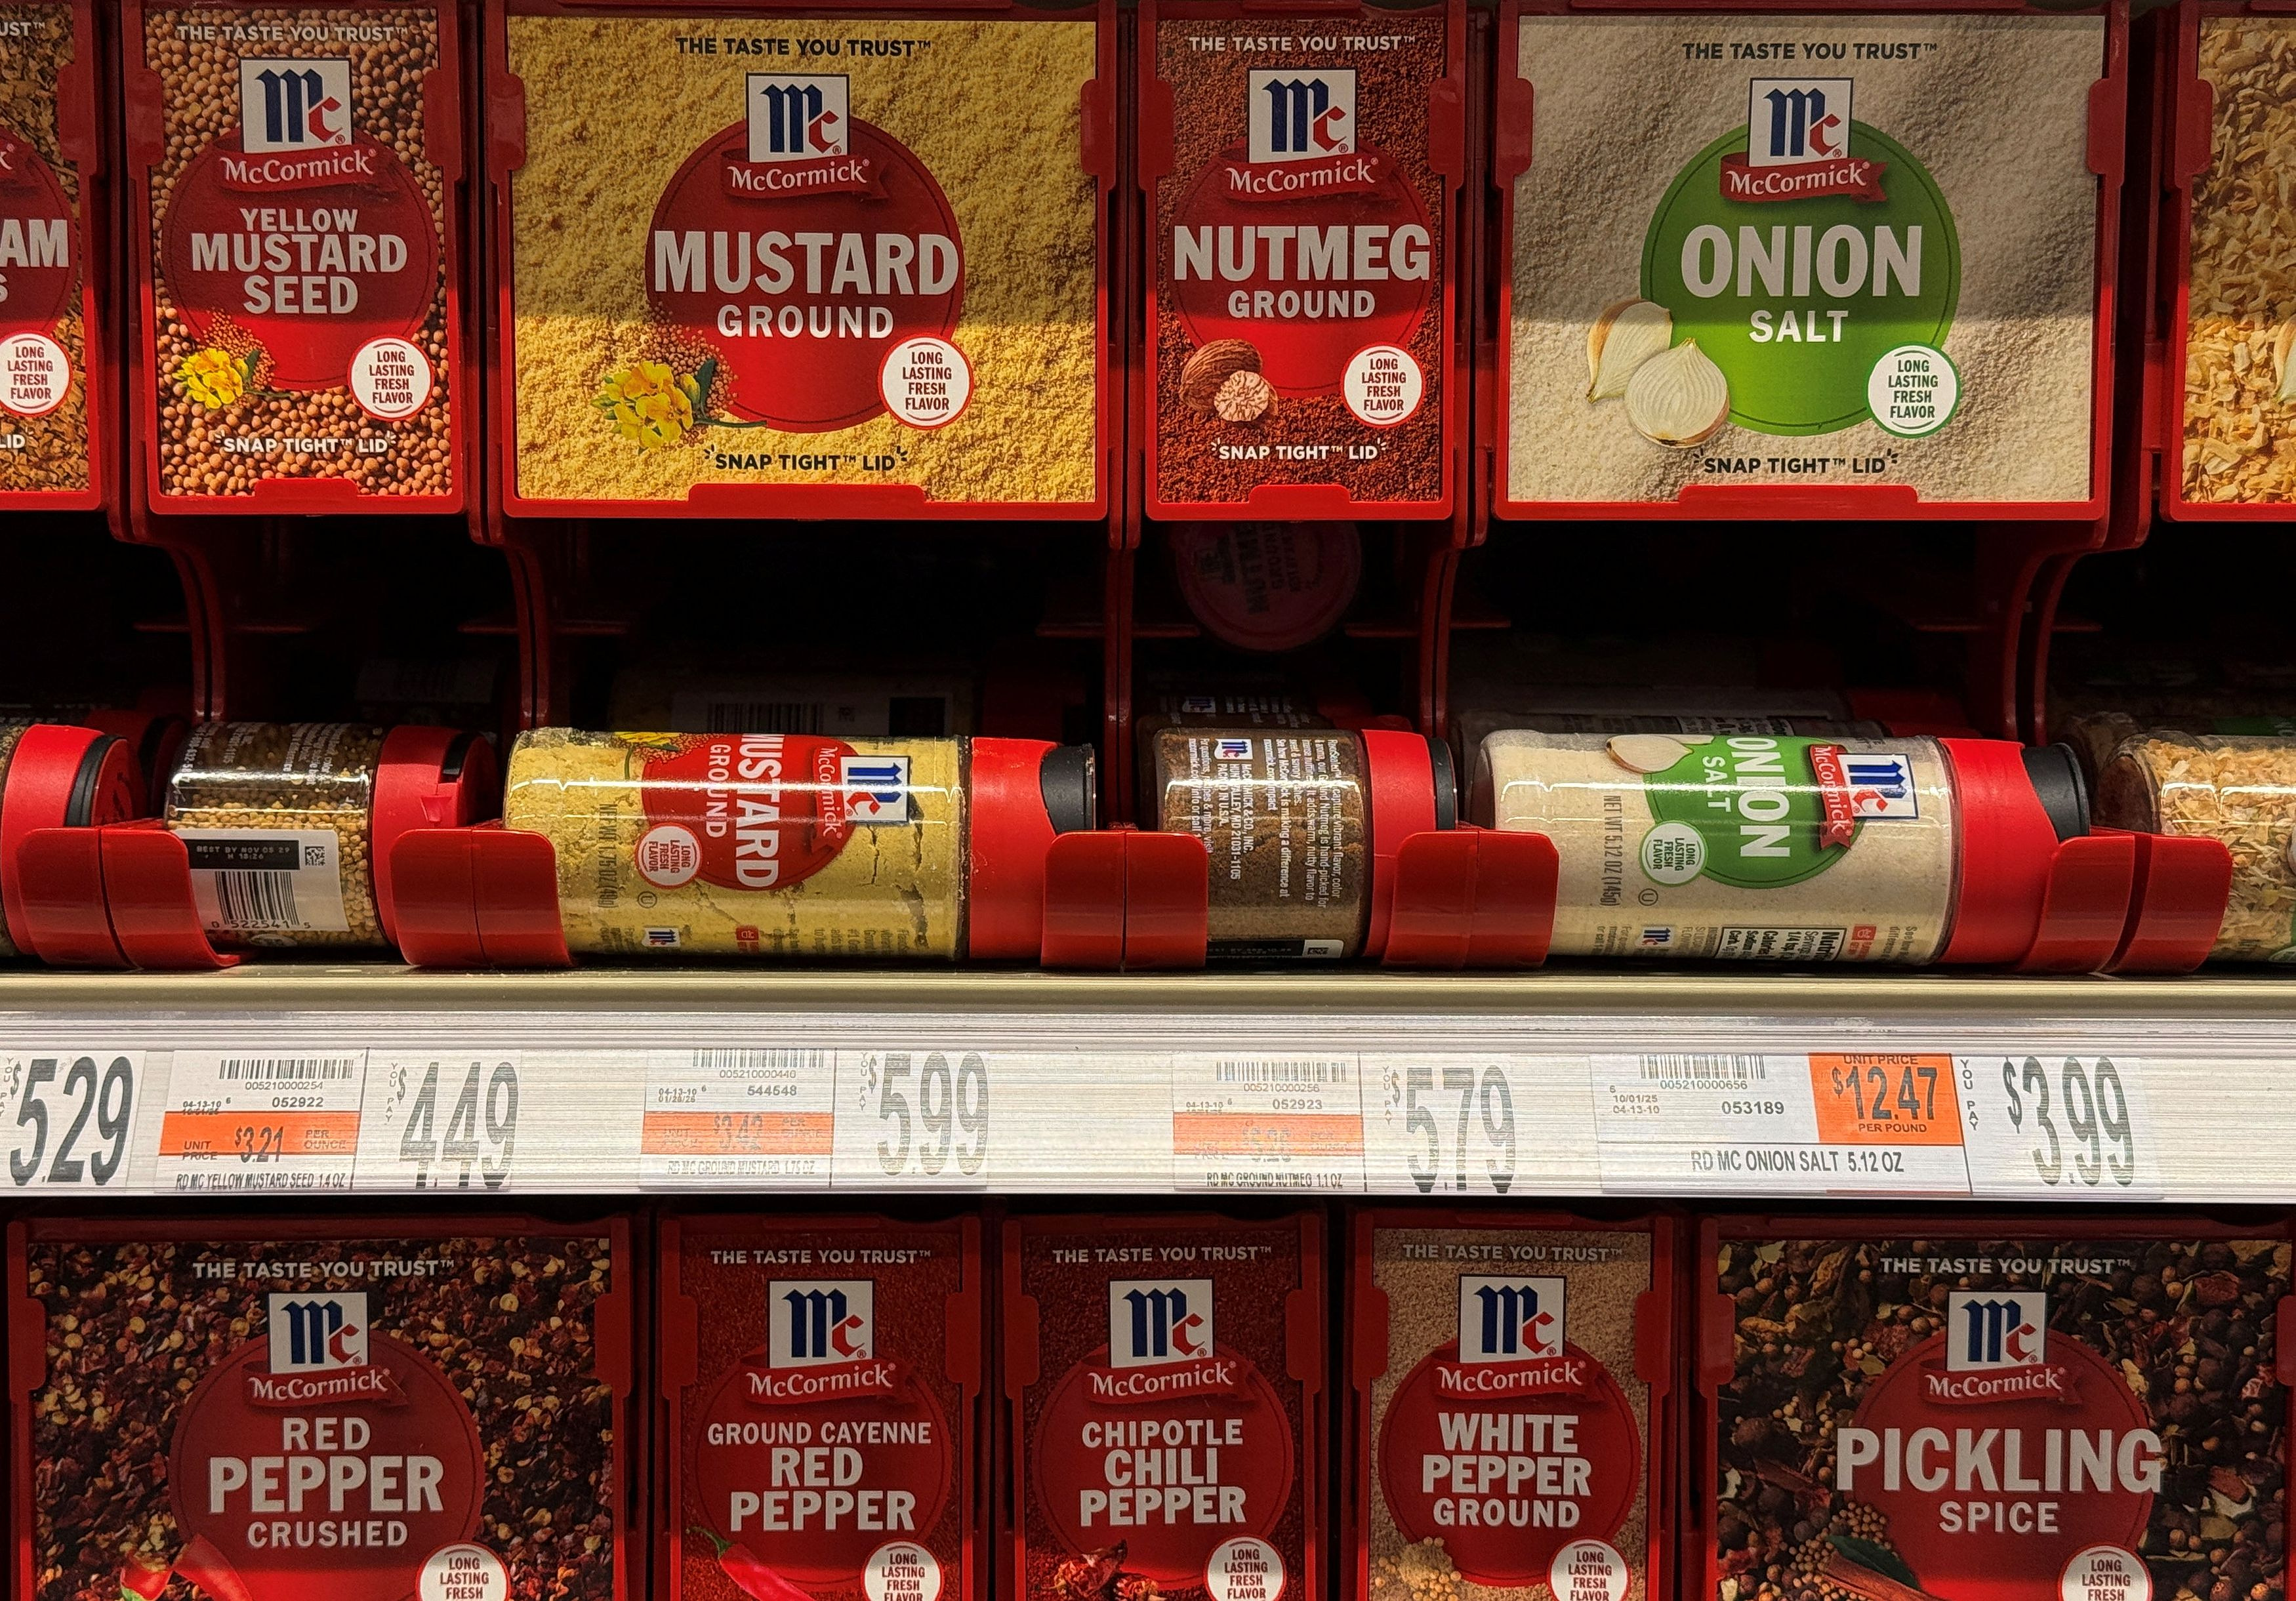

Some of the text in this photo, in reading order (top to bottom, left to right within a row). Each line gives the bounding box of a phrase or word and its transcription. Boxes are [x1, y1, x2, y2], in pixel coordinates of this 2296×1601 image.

[178, 26, 215, 40] THE
[222, 27, 283, 41] TASTE
[290, 28, 329, 41] YOU
[676, 37, 717, 54] THE
[724, 38, 789, 55] TASTE
[797, 39, 840, 56] YOU
[1189, 36, 1226, 51] THE
[1233, 36, 1292, 52] TASTE
[1300, 36, 1338, 52] YOU
[240, 208, 358, 233] YELLOW
[191, 233, 408, 272] MUSTARD
[655, 231, 958, 296] MUSTARD
[1174, 224, 1431, 281] NUTMEG
[1681, 224, 1923, 298] ONION
[243, 275, 358, 314] SEED
[1228, 290, 1376, 318] GROUND
[717, 305, 893, 339] GROUND
[1749, 310, 1849, 343] SALT
[16, 347, 44, 358] LONG
[377, 351, 405, 363] LONG
[8, 361, 53, 372] LASTING
[13, 374, 48, 385] FRESH
[369, 364, 415, 377] LASTING
[10, 388, 51, 399] FLAVOR
[375, 377, 410, 390] FRESH
[372, 392, 413, 405] FLAVOR
[223, 438, 276, 453] SNAP
[358, 438, 388, 453] LID
[1705, 457, 1761, 474] SNAP
[1853, 458, 1887, 474] LID
[706, 744, 731, 838] GROUND
[1727, 738, 1790, 857] ONION
[736, 734, 785, 887] MUSTARD
[1604, 796, 1622, 813] NET
[1332, 821, 1343, 850] vibrant
[1605, 816, 1622, 833] WT
[649, 841, 658, 872] FLAVOR
[660, 843, 669, 870] FRESH
[670, 840, 680, 873] LASTING
[682, 845, 691, 868] LONG
[1230, 830, 1241, 880] 21031-1105
[1279, 808, 1291, 887] making difference
[1605, 836, 1622, 856] 5.12
[1653, 840, 1662, 870] FLAVOR
[1664, 841, 1673, 867] FRESH
[1675, 838, 1684, 871] LASTING
[1686, 843, 1695, 865] LONG
[1318, 846, 1330, 895] hand-picked
[1605, 861, 1622, 874] OZ
[1331, 878, 1342, 898] color
[1599, 876, 1622, 906] (145g)
[1843, 1055, 1919, 1065] UNIT PRICE
[245, 1082, 323, 1090] 005210000254
[1660, 1080, 1748, 1090] 005210000656
[1832, 1065, 1937, 1120] $12.47
[272, 1097, 324, 1108] 052922
[1273, 1099, 1323, 1110] 052923
[1612, 1095, 1658, 1103] 10/01/25
[1721, 1101, 1785, 1115] 053189
[10, 1056, 134, 1186] $5.29
[397, 1062, 518, 1189] $4.49
[869, 1052, 989, 1175] $5.99
[2003, 1055, 2134, 1186] $3.99
[1858, 1124, 1927, 1133] PER POUND
[182, 1152, 218, 1160] PRICE
[184, 1141, 212, 1150] UNIT
[235, 1125, 284, 1163] $3.21
[1691, 1150, 1904, 1173] RD MC ONION SALT 5.12 OZ
[207, 1173, 244, 1188] YELLOW
[245, 1173, 289, 1188] MUSTARD
[290, 1173, 314, 1188] SEED
[1236, 1173, 1273, 1188] GROUND
[1275, 1173, 1312, 1188] NUTMEG
[1403, 1244, 1439, 1259] THE
[1445, 1244, 1503, 1260] TASTE
[1509, 1246, 1546, 1261] YOU
[282, 1417, 371, 1451] RED
[707, 1422, 932, 1446] GROUND CAYENNE
[1082, 1418, 1244, 1447] CHIPOTLE
[1438, 1412, 1579, 1453] WHITE
[771, 1447, 864, 1488] RED
[1103, 1448, 1218, 1487] CHILI
[1837, 1428, 2162, 1495] PICKLING
[209, 1456, 445, 1514] PEPPER
[1422, 1454, 1591, 1497] PEPPER
[729, 1490, 916, 1532] PEPPER
[1080, 1486, 1248, 1527] PEPPER
[1433, 1499, 1580, 1528] GROUND
[1939, 1502, 2059, 1533] SPICE
[247, 1521, 409, 1549] CRUSHED
[1224, 1562, 1268, 1574] LASTING
[1231, 1549, 1260, 1561] LONG
[1226, 1587, 1266, 1599] FLAVOR
[1229, 1574, 1264, 1586] FRESH
